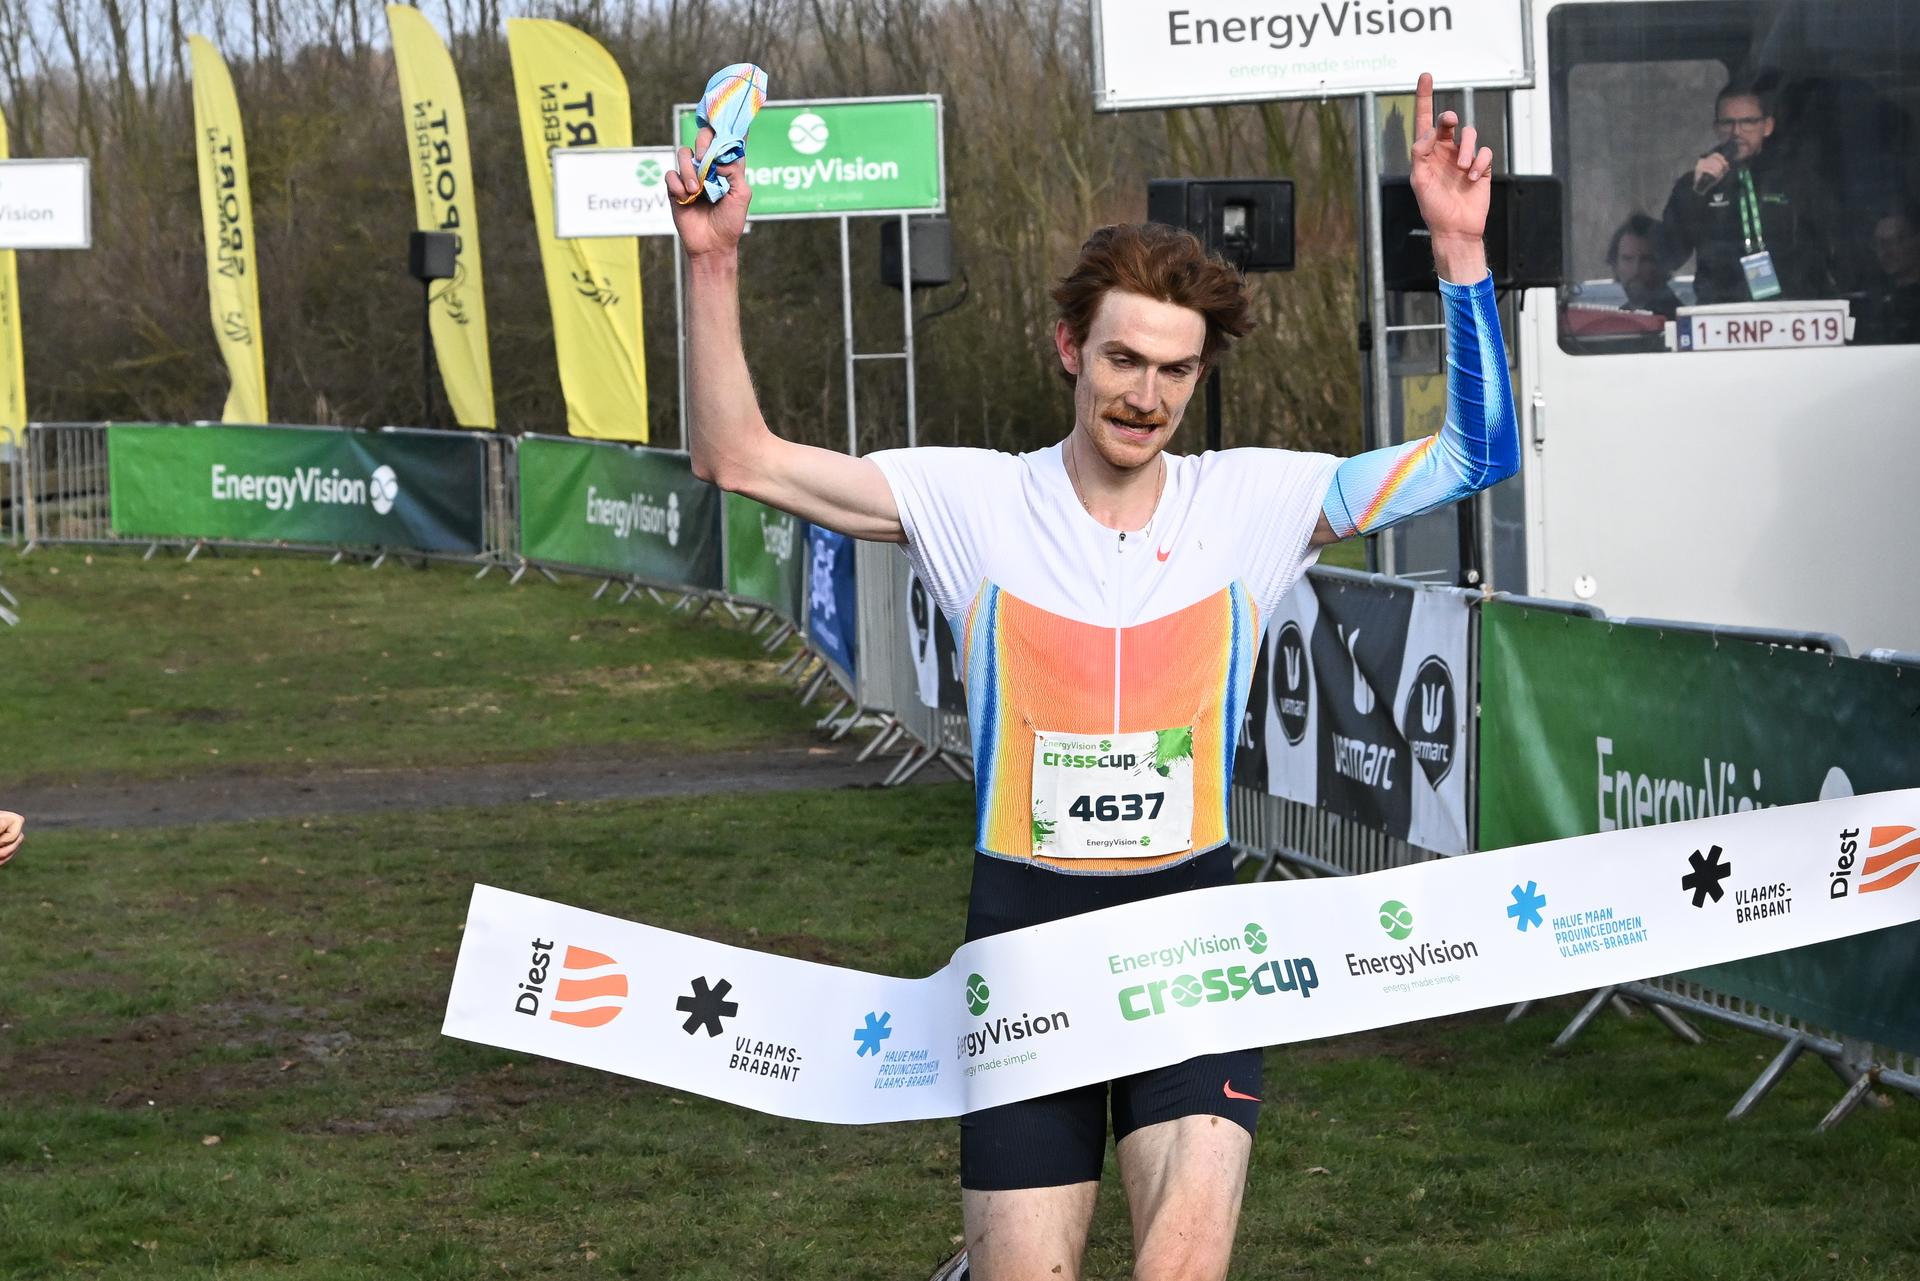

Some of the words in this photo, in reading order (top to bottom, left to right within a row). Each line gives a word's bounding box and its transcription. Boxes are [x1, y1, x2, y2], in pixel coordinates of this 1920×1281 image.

[1168, 0, 1453, 49] EnergyVision
[1229, 63, 1289, 80] energy
[1292, 58, 1338, 74] made
[1343, 54, 1397, 71] simple
[748, 158, 899, 191] nergyVision
[588, 193, 667, 214] EnergyV
[211, 465, 366, 509] EnergyVision
[586, 486, 666, 538] EnergyVision
[1043, 740, 1097, 751] EnergyVision
[1043, 752, 1136, 770] crosscup
[1068, 791, 1165, 822] 4637
[1086, 838, 1137, 848] EnergyVision
[1830, 827, 1860, 899] Diest
[1735, 882, 1792, 906] VLAAMS-
[1552, 913, 1584, 931] HALVE
[1585, 907, 1613, 926] MAAN
[1736, 898, 1792, 924] BRABANT
[1555, 916, 1642, 945] PROVINCIEDOMEIN
[1559, 929, 1648, 958] VLAAMS-BRABANT
[1108, 934, 1241, 975] EnergyVision
[1345, 937, 1479, 977] EnergyVision
[514, 937, 555, 1017] Diest
[1382, 981, 1409, 995] energy
[1410, 977, 1432, 990] made
[1433, 972, 1461, 987] simple
[735, 1036, 802, 1062] VLAAMS-
[883, 1050, 909, 1062] HALVE
[907, 1049, 929, 1062] MAAN
[977, 1058, 1002, 1073] made
[1003, 1050, 1038, 1067] simple
[728, 1053, 801, 1083] BRABANT
[874, 1073, 939, 1089] VLAAMS-BRABANT
